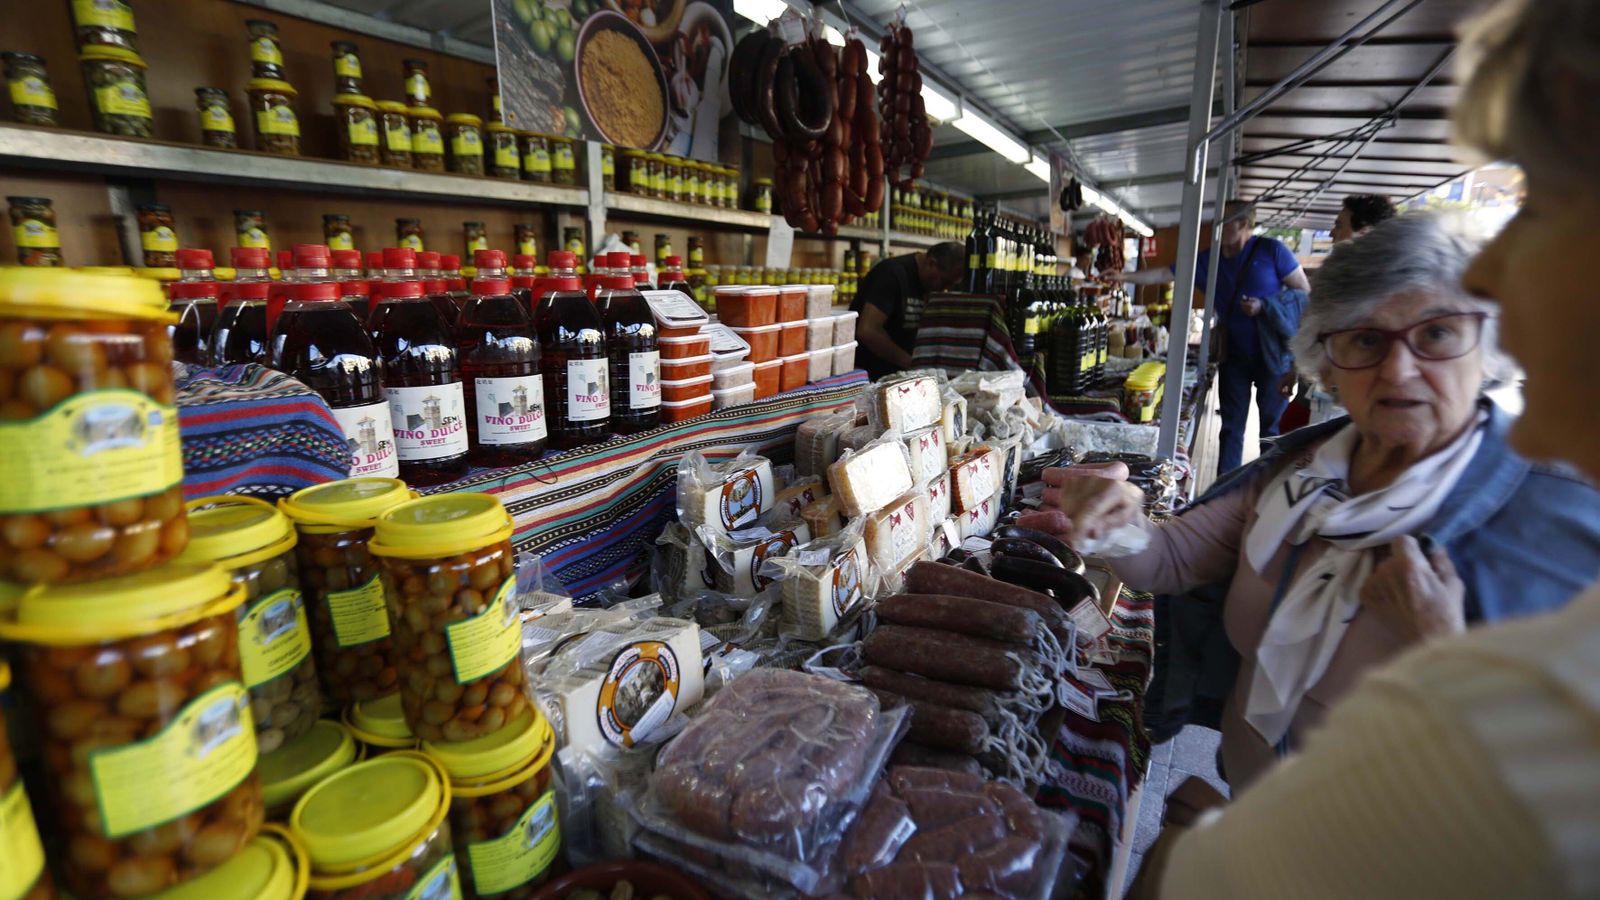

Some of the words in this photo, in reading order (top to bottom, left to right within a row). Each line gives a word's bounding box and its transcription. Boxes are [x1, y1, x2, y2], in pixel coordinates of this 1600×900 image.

[575, 394, 598, 403] VINO
[484, 415, 514, 426] VINO
[393, 428, 425, 440] VINO
[431, 421, 463, 438] DULCE
[420, 438, 447, 446] SWEET
[356, 462, 382, 474] SWEET
